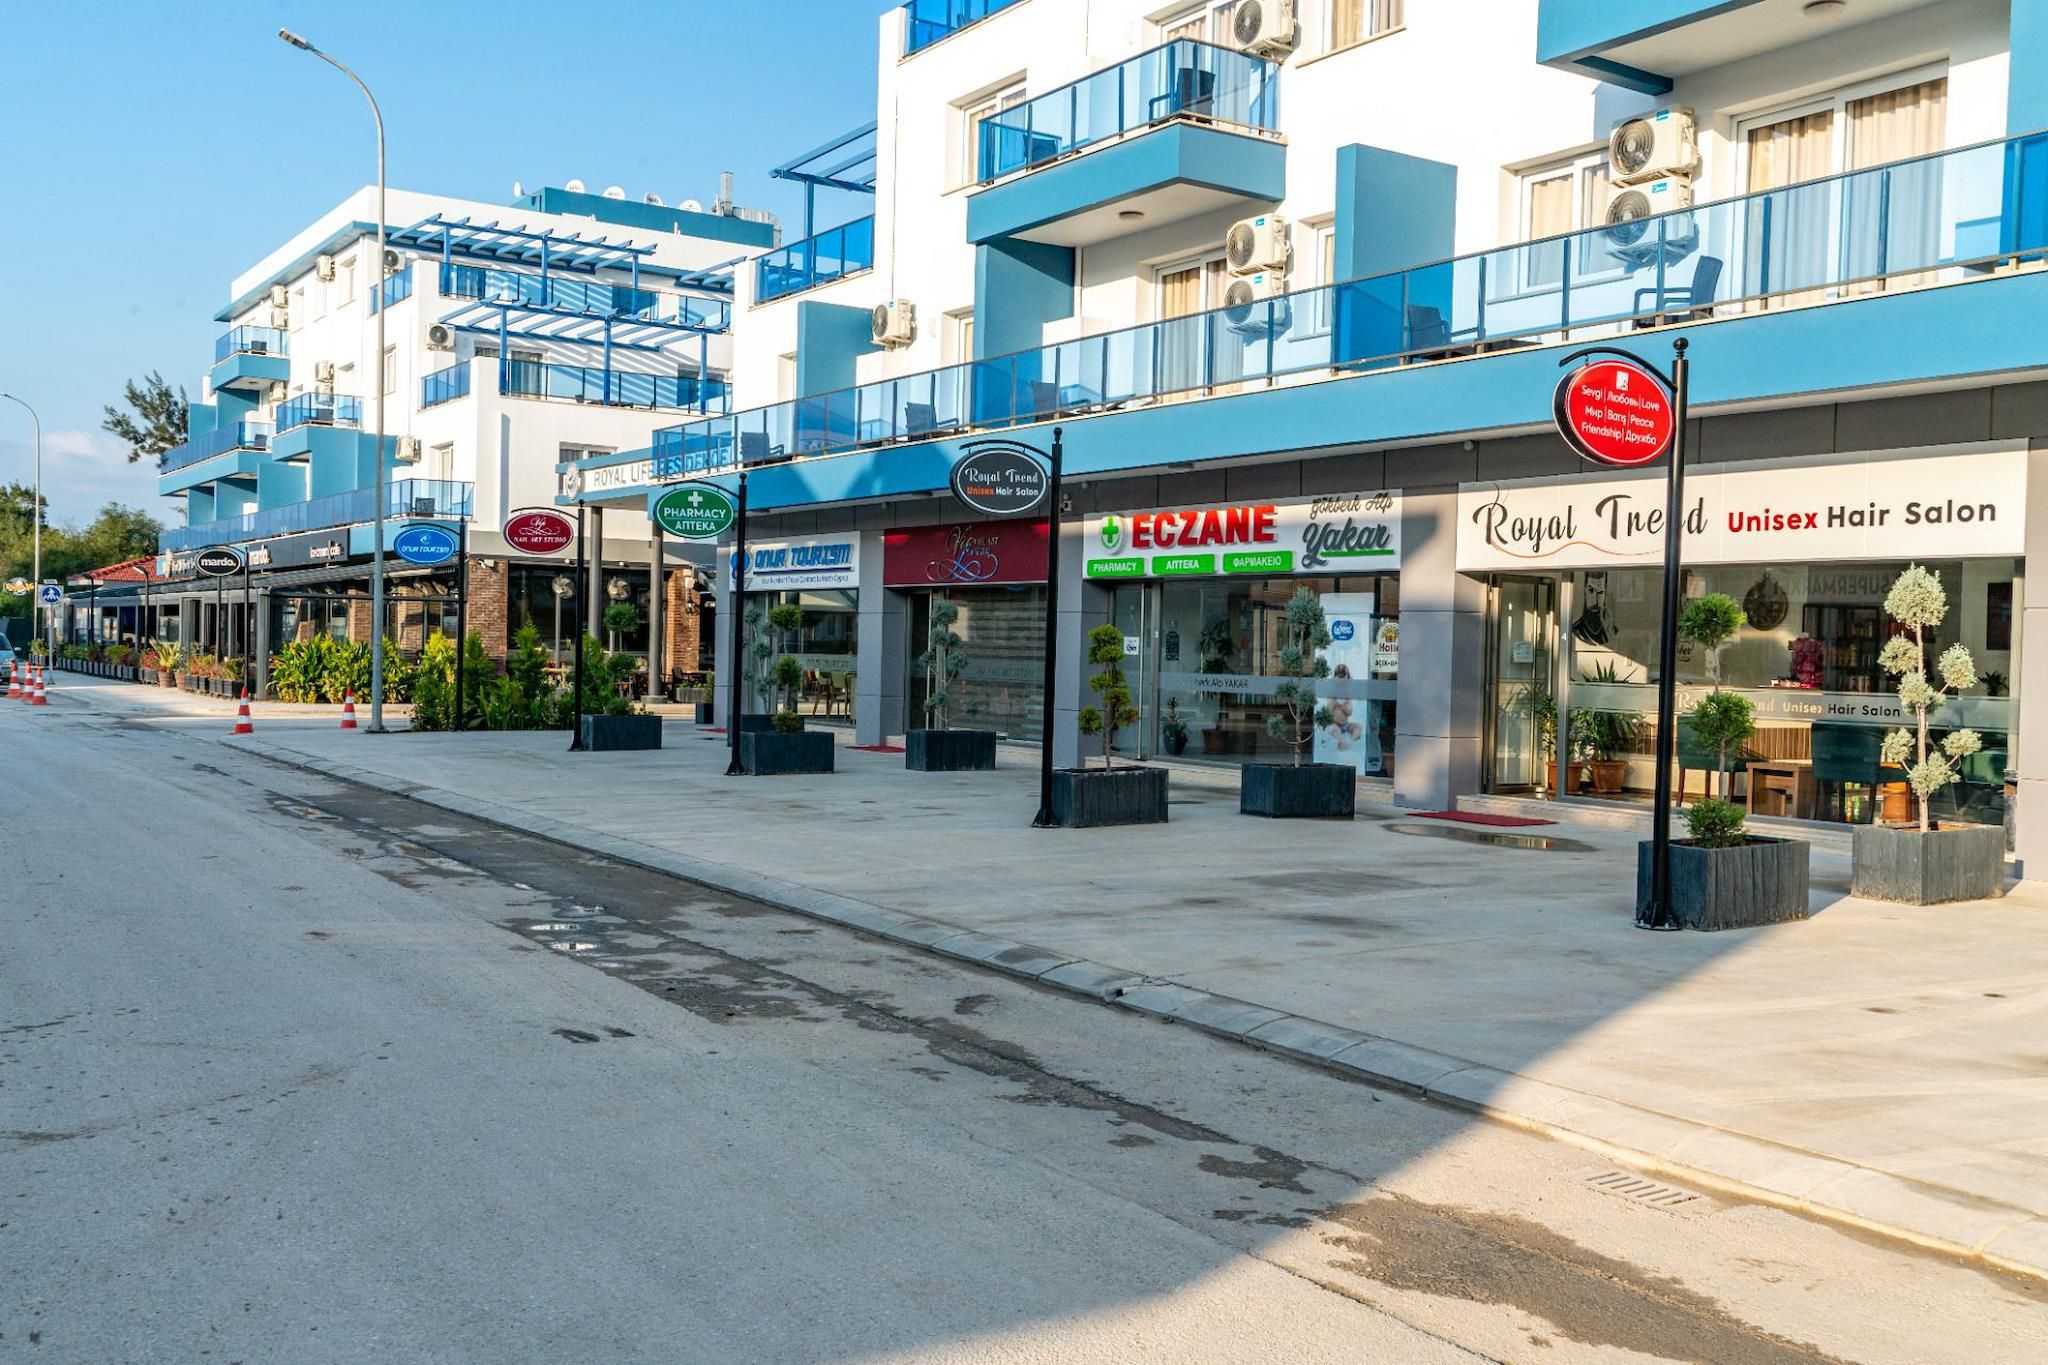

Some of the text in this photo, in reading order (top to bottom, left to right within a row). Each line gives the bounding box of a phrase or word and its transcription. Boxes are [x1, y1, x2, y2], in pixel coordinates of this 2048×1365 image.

[1581, 385, 1603, 400] Sevgi
[1641, 397, 1660, 412] Love
[1585, 406, 1604, 419] Мир
[1630, 414, 1655, 429] Peace
[1581, 421, 1657, 446] Friendship Дружба
[594, 467, 626, 487] ROYAL
[965, 467, 1038, 485] Royal Trend
[966, 486, 1039, 496] Unisex Hair Salon
[664, 507, 726, 519] PHARMACY
[1472, 494, 1997, 553] Royal Tred Unisex Hair Salon
[1132, 505, 1276, 548] ECZANE
[1302, 517, 1391, 569] Yakar
[755, 548, 787, 569] ONUR
[1093, 561, 1137, 572] PHARMACY
[1828, 703, 1856, 715] Hair
[1862, 705, 1900, 717] Salon
